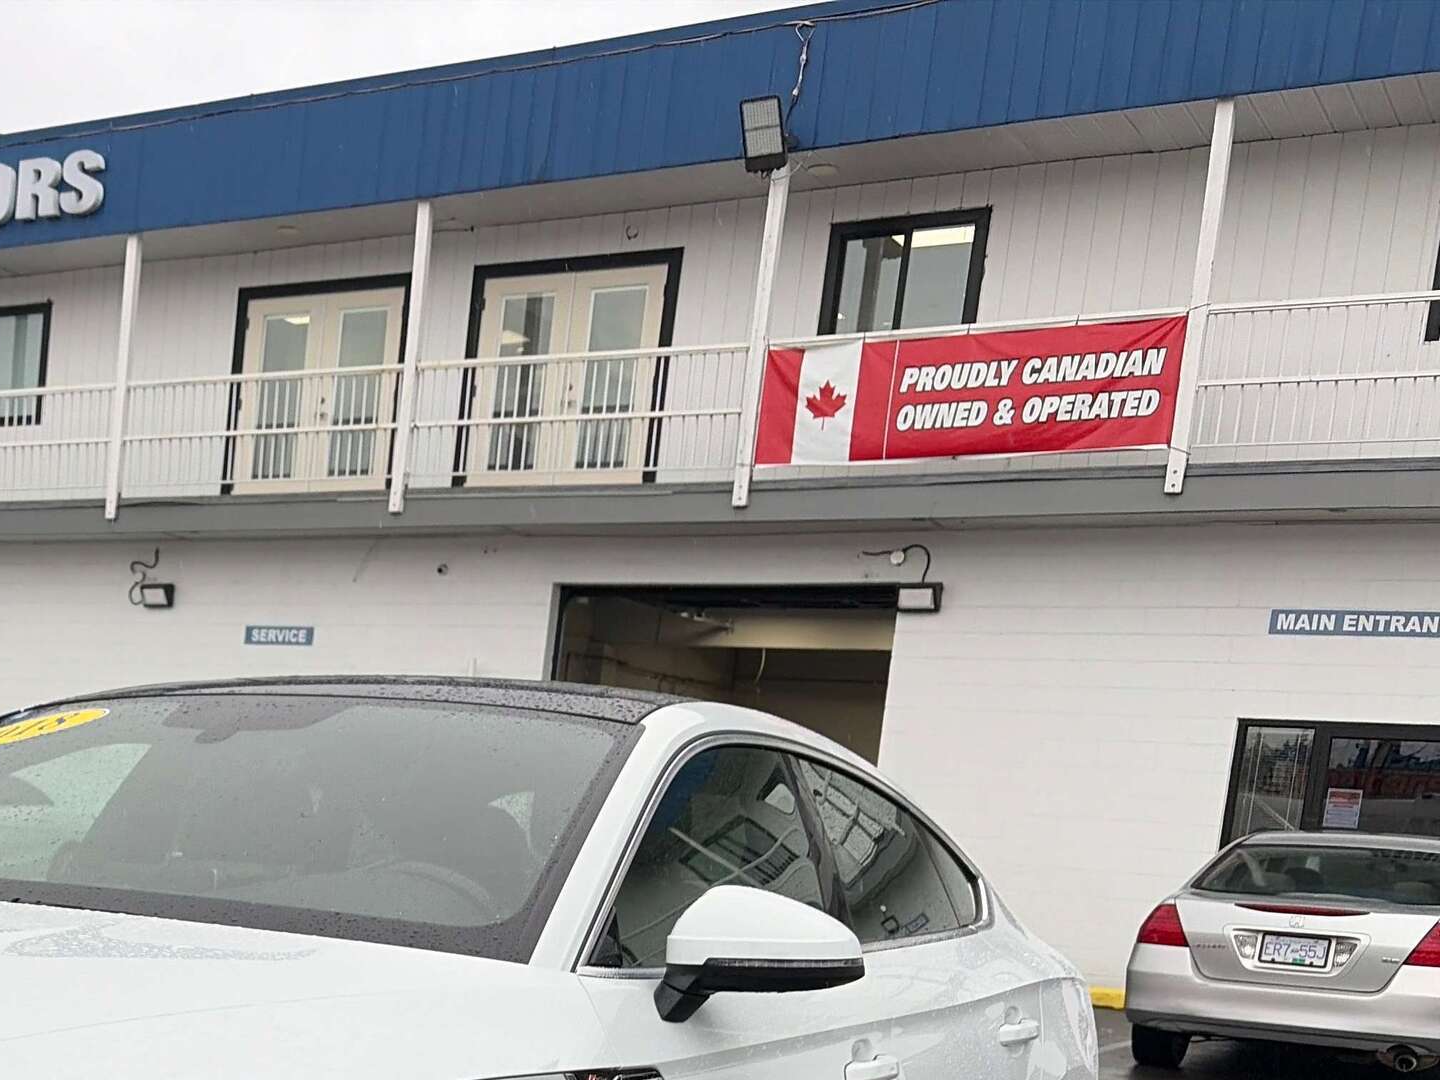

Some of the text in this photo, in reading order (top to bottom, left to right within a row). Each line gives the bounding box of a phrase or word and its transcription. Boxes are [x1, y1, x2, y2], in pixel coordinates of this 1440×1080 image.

[900, 347, 1167, 394] PROUDLY CANADIAN
[896, 388, 1161, 432] OWNED & OPERATED
[251, 628, 308, 643] SERVICE
[1276, 613, 1440, 634] MAIN ENTRAN
